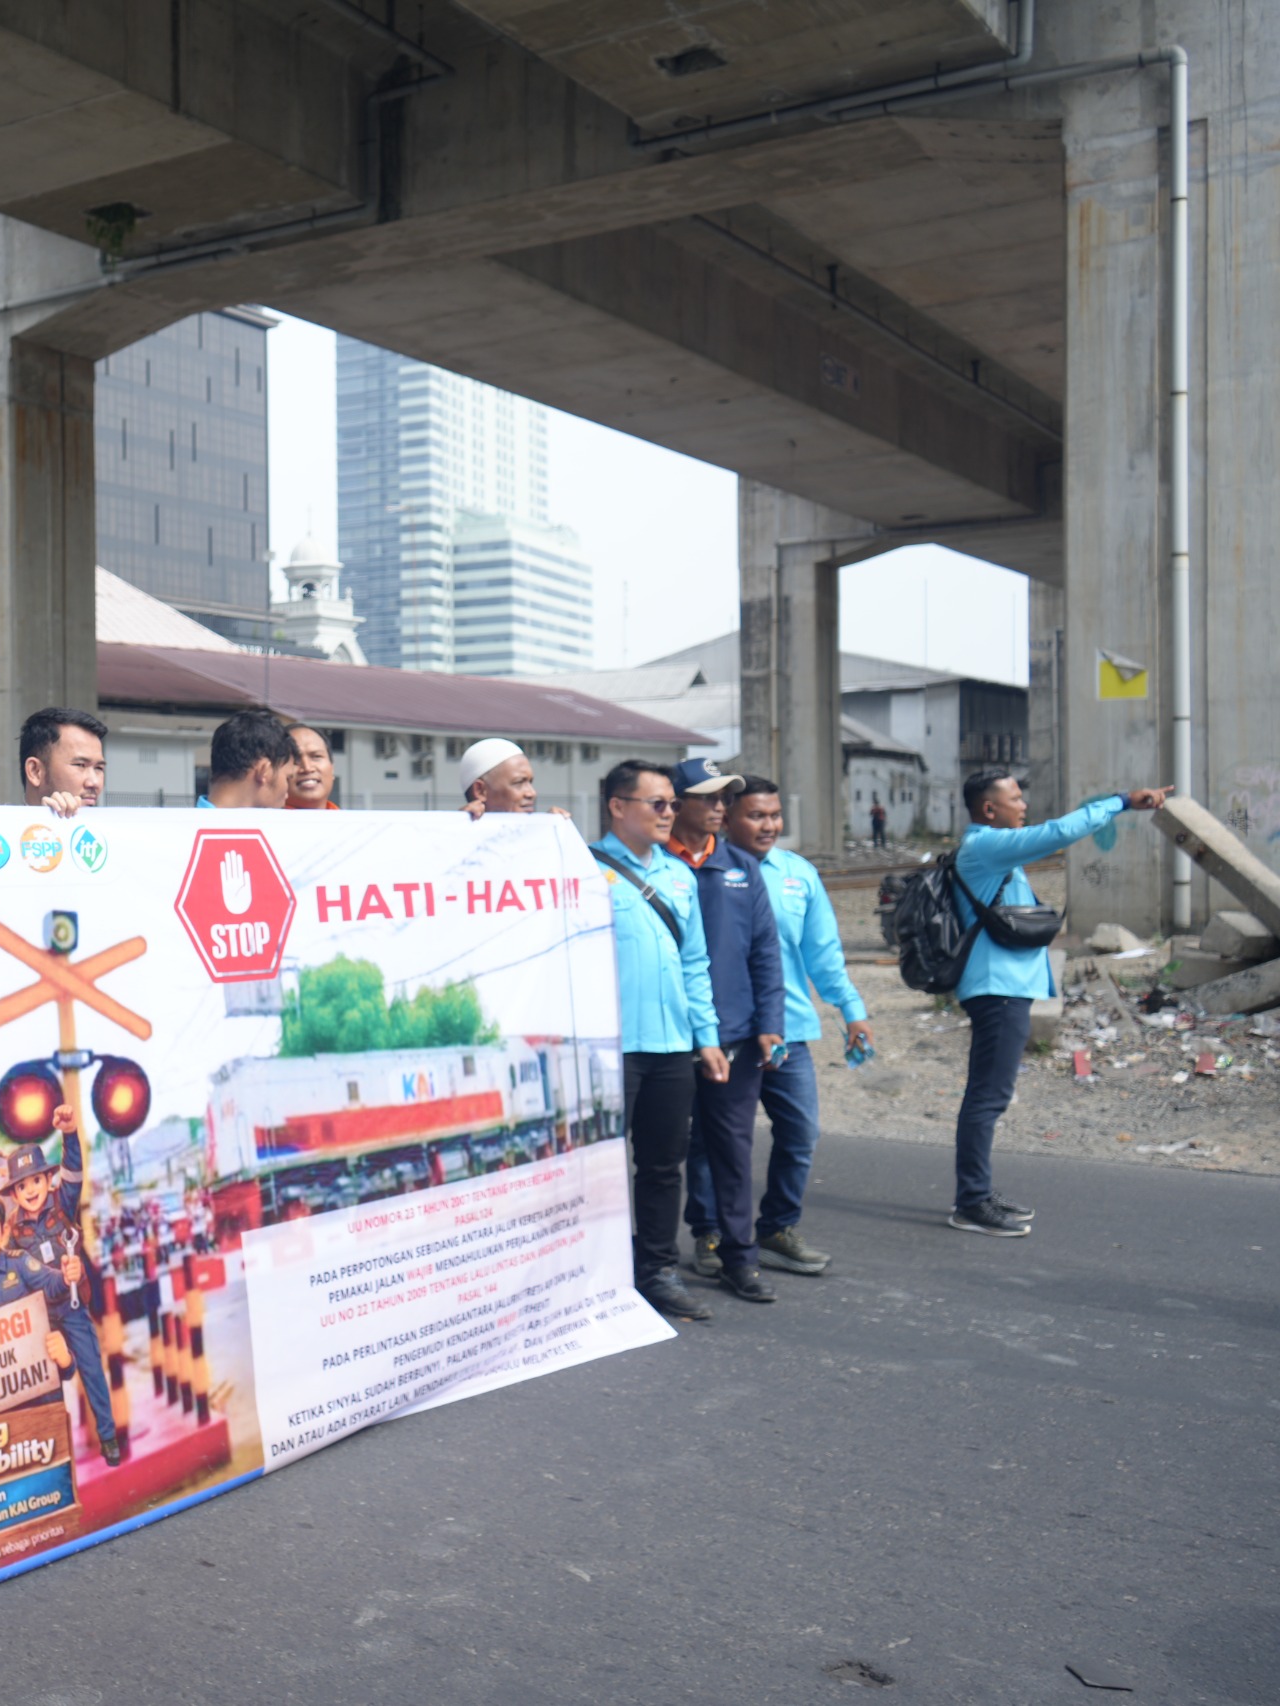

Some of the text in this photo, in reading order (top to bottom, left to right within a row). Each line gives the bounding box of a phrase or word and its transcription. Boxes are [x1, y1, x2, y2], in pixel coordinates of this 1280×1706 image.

[21, 842, 62, 857] FSPP
[316, 882, 435, 923] HATI
[211, 923, 270, 960] STOP
[347, 1222, 363, 1234] UU
[364, 1212, 402, 1230] NOMOR
[418, 1198, 449, 1216] TAHUN
[454, 1212, 478, 1227] PASAL
[309, 1269, 338, 1287] PADA
[340, 1249, 414, 1279] PERPOTONGAN
[415, 1235, 460, 1258] SEBIDANG
[461, 1226, 493, 1245] ANTARA
[328, 1281, 373, 1304] PEMAKAI
[375, 1271, 405, 1294] JALAN
[435, 1242, 504, 1272] MENDAHULUKAN
[320, 1313, 336, 1328] UU
[338, 1307, 354, 1322] NO
[357, 1304, 369, 1317] 22
[370, 1293, 405, 1312] TAHUN
[407, 1285, 428, 1303] 2009
[429, 1272, 468, 1294] TENTANG
[458, 1289, 482, 1305] PASAL
[322, 1351, 351, 1371] PADA
[353, 1330, 418, 1361] PERLINTASAN
[393, 1339, 444, 1368] PENGEMUDI
[446, 1320, 496, 1347] KENDARAAN
[287, 1404, 324, 1428] KETIKA
[326, 1392, 362, 1413] SINYAL
[364, 1377, 396, 1400] SUDAH
[271, 1437, 296, 1457] DAN
[297, 1427, 325, 1448] ATAU
[326, 1417, 347, 1435] ADA
[349, 1400, 387, 1426] ISYARAT
[9, 1500, 29, 1518] KAI
[28, 1490, 62, 1513] Group
[1, 1535, 31, 1558] sebagai
[30, 1524, 65, 1548] prioritas
